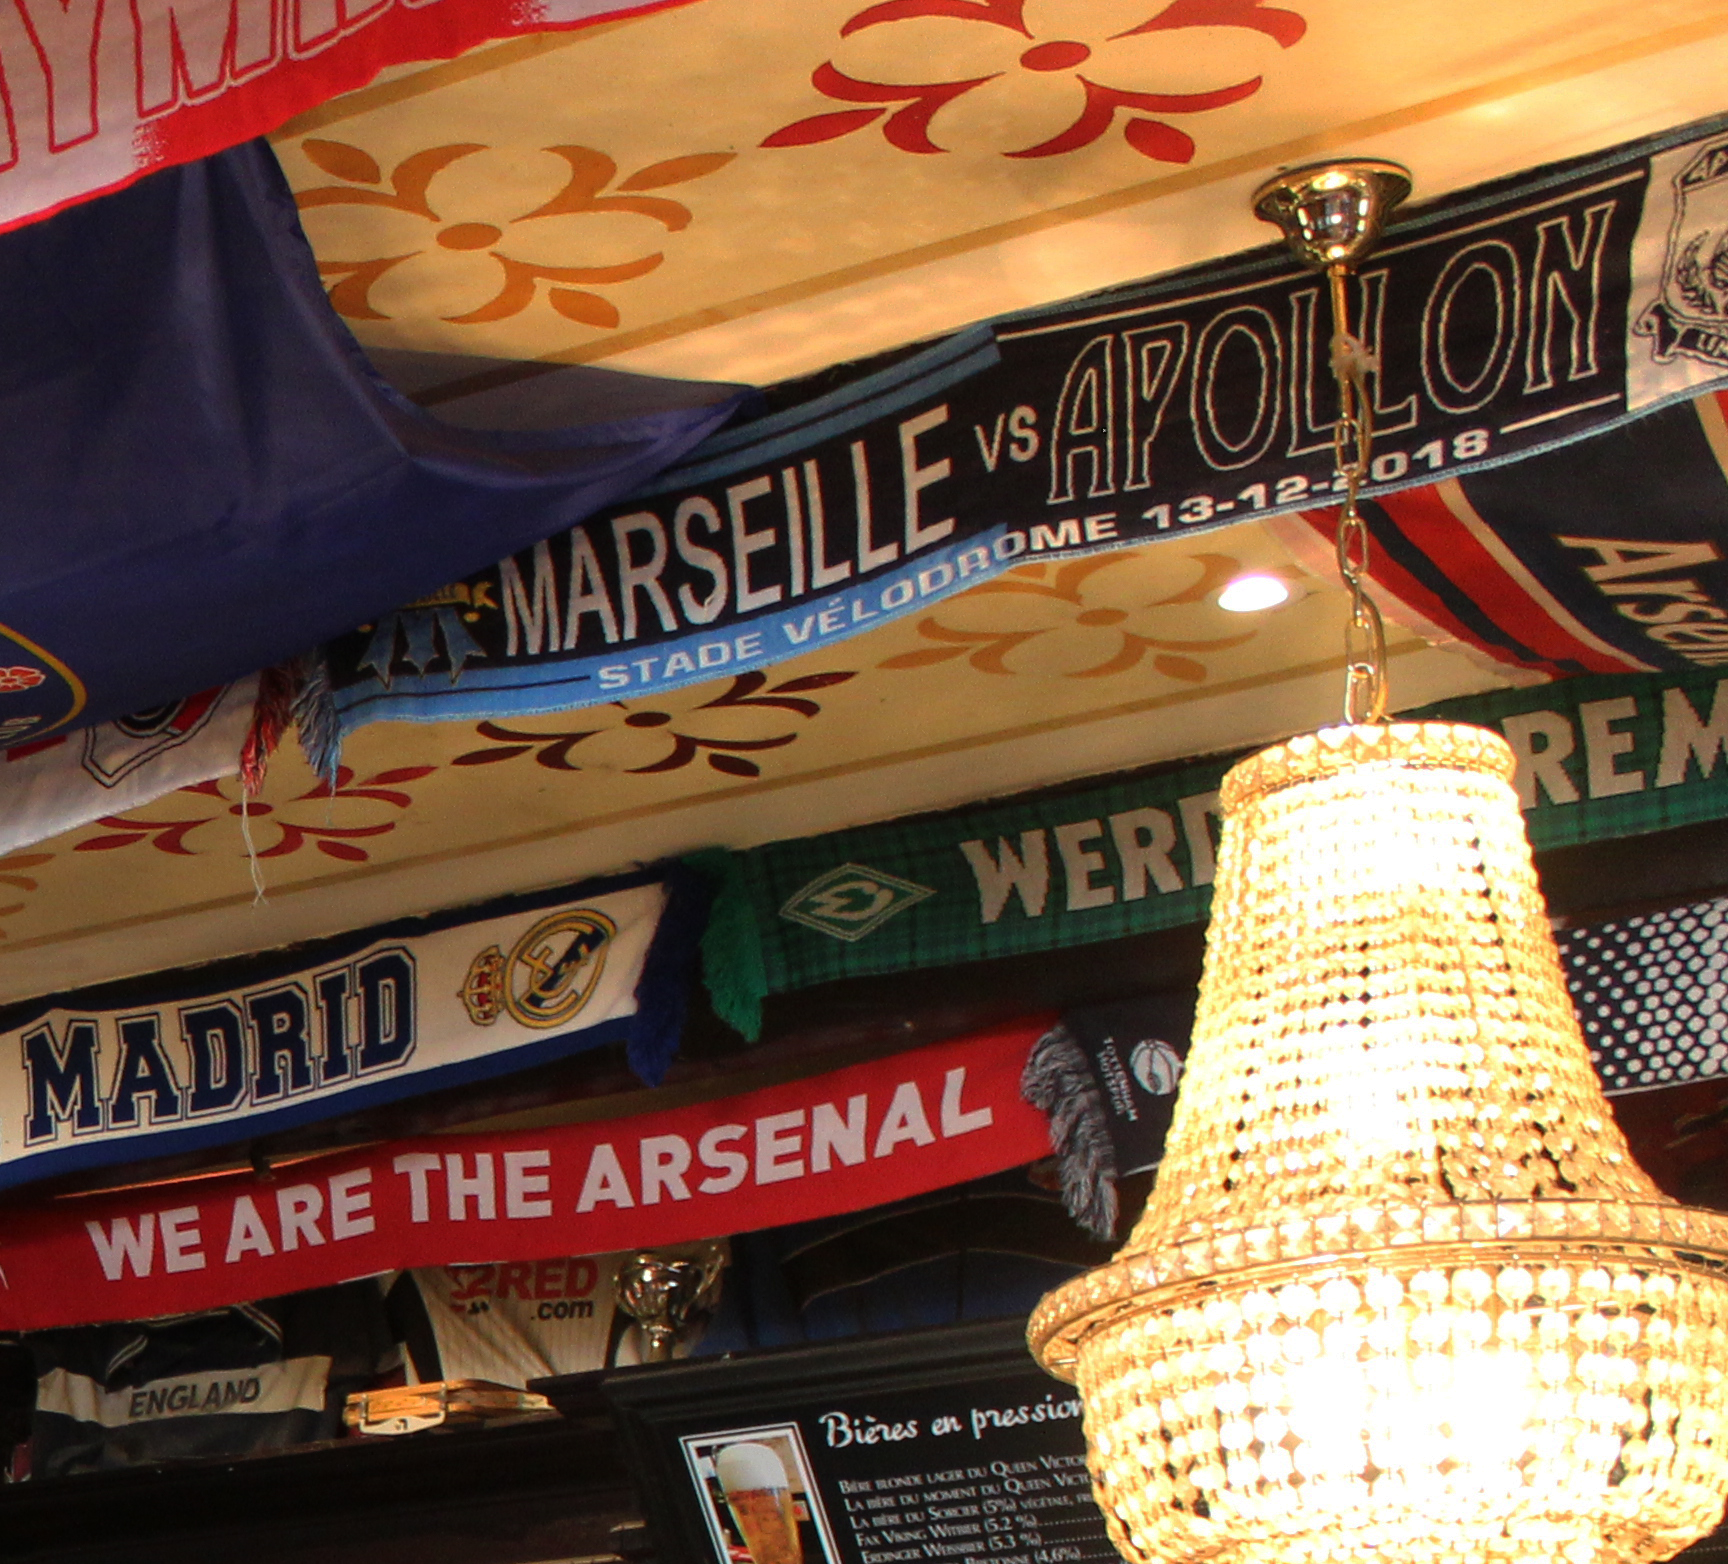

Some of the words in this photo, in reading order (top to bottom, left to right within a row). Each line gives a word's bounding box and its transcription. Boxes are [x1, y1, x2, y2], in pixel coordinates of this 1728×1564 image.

[499, 403, 957, 659] MARSEILLE
[973, 405, 1040, 472] VS
[1047, 200, 1616, 507] APOLLON
[597, 632, 764, 691] STADE
[784, 512, 1118, 647] VÉLODROME
[1141, 428, 1488, 531] 13-12-2018
[20, 944, 420, 1149] MADRID
[85, 1207, 206, 1283] WE
[225, 1167, 376, 1262] ARE
[393, 1151, 552, 1224] THE
[577, 1067, 994, 1215] ARSENAL
[127, 1376, 262, 1419] ENGLAND
[530, 1297, 594, 1322] .com
[818, 1411, 918, 1448] Bières
[931, 1415, 962, 1436] en
[970, 1394, 1085, 1440] pression
